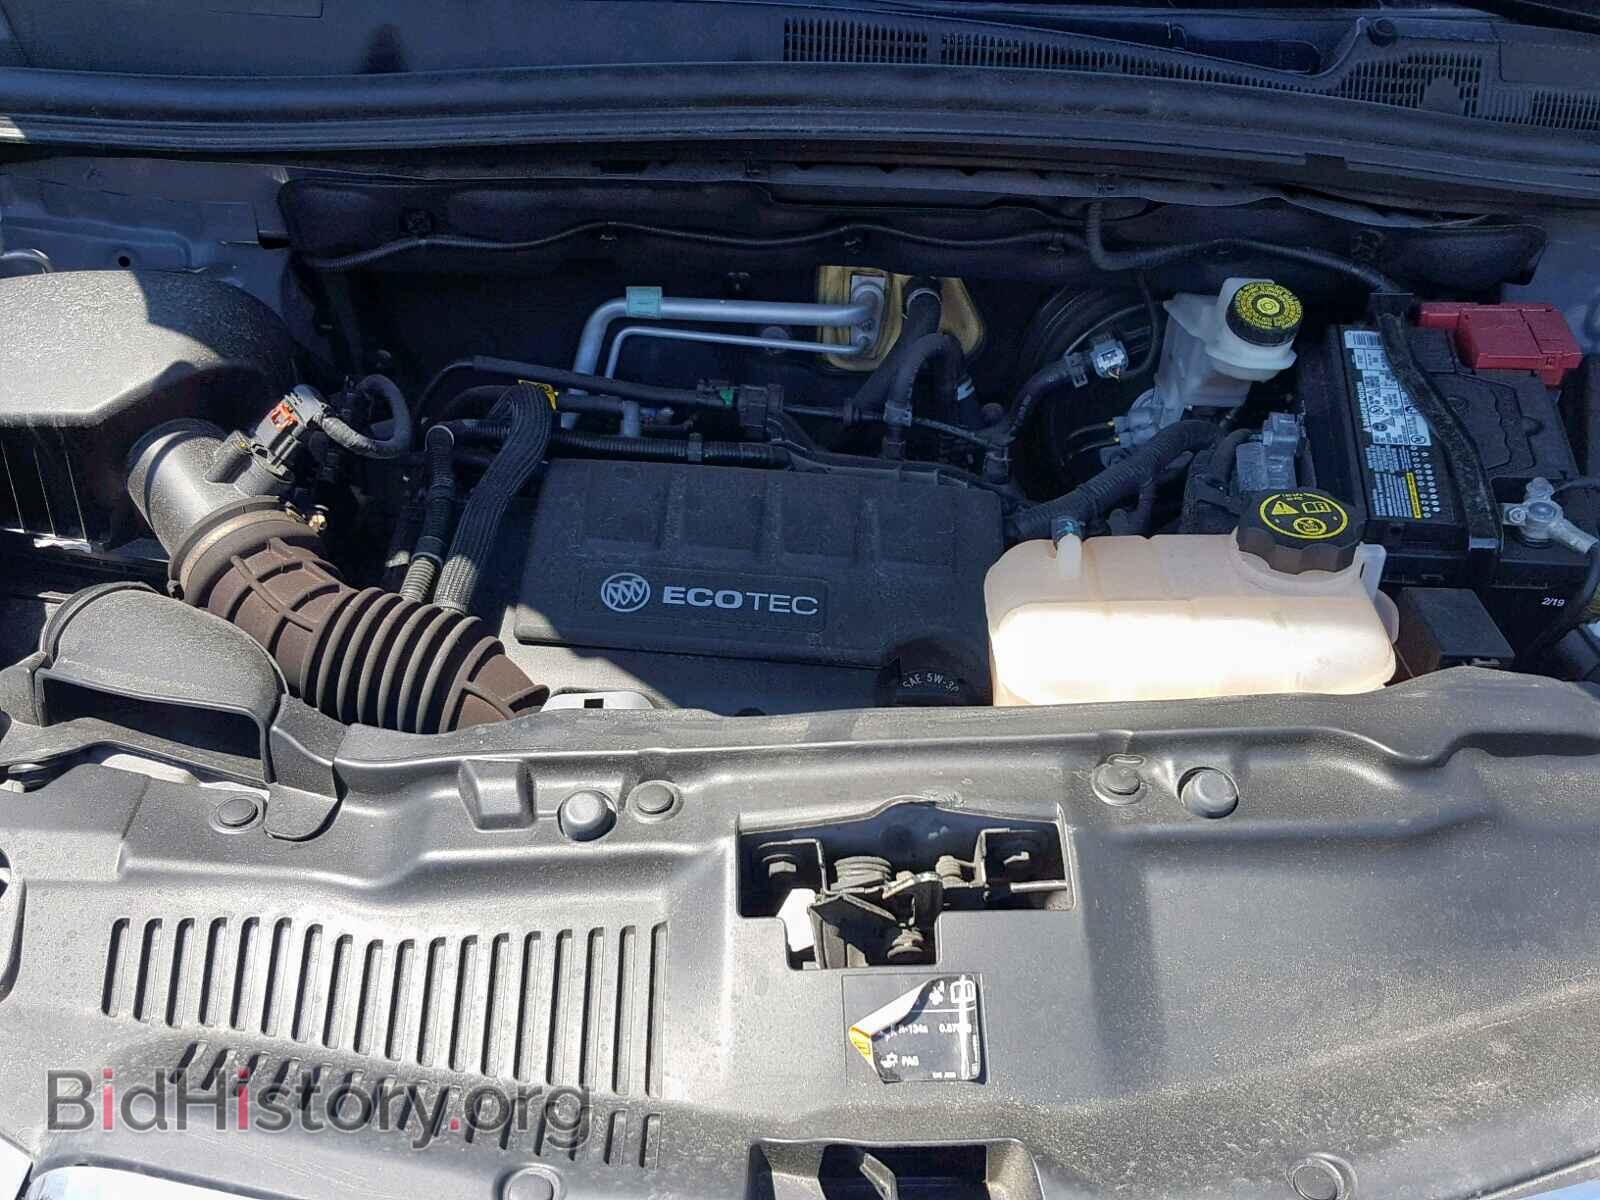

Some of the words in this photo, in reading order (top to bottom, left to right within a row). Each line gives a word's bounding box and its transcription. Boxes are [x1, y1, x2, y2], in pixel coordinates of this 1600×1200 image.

[662, 585, 819, 615] ECOTEC
[1541, 597, 1565, 607] 2/19
[902, 673, 922, 689] SAE
